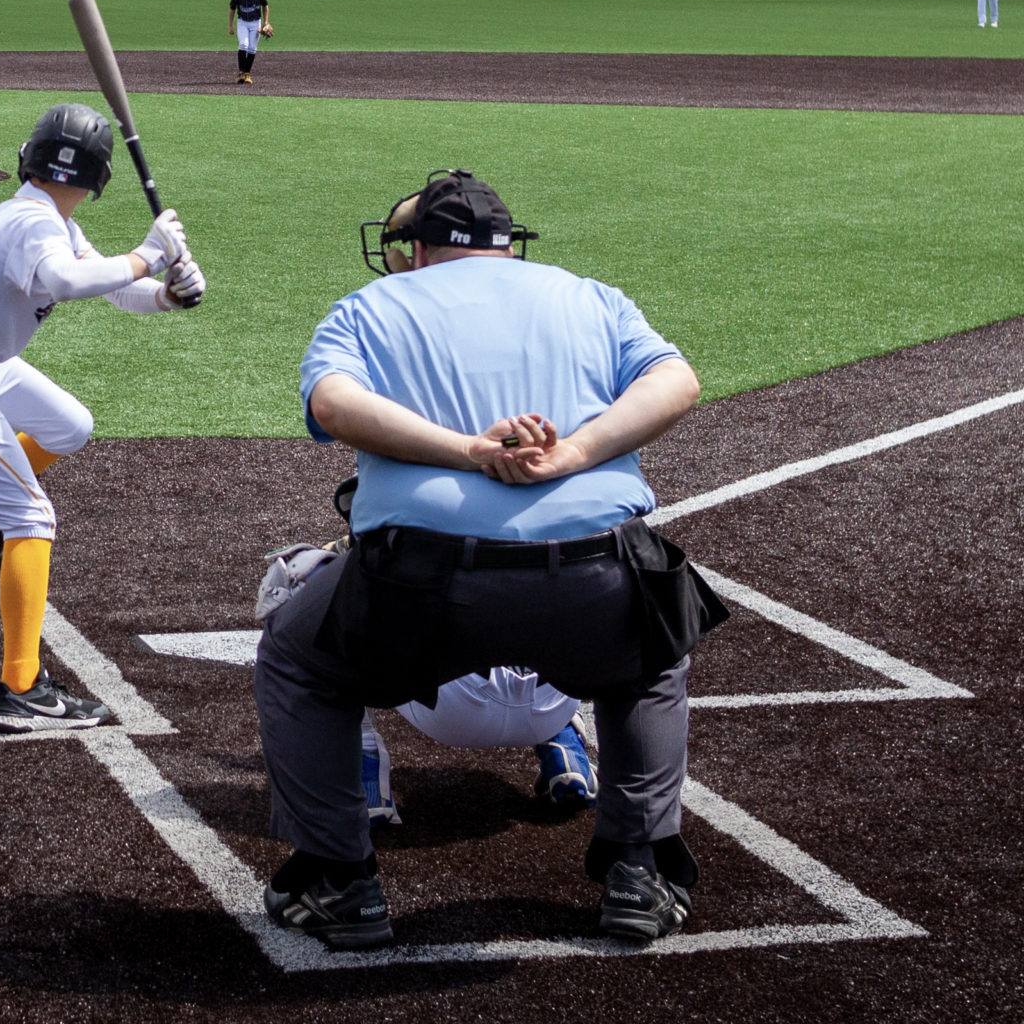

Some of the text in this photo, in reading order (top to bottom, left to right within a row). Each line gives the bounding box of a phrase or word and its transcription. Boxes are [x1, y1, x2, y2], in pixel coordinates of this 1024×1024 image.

[450, 230, 471, 245] Pro
[609, 889, 642, 903] Reebok
[360, 904, 386, 916] Reebo
